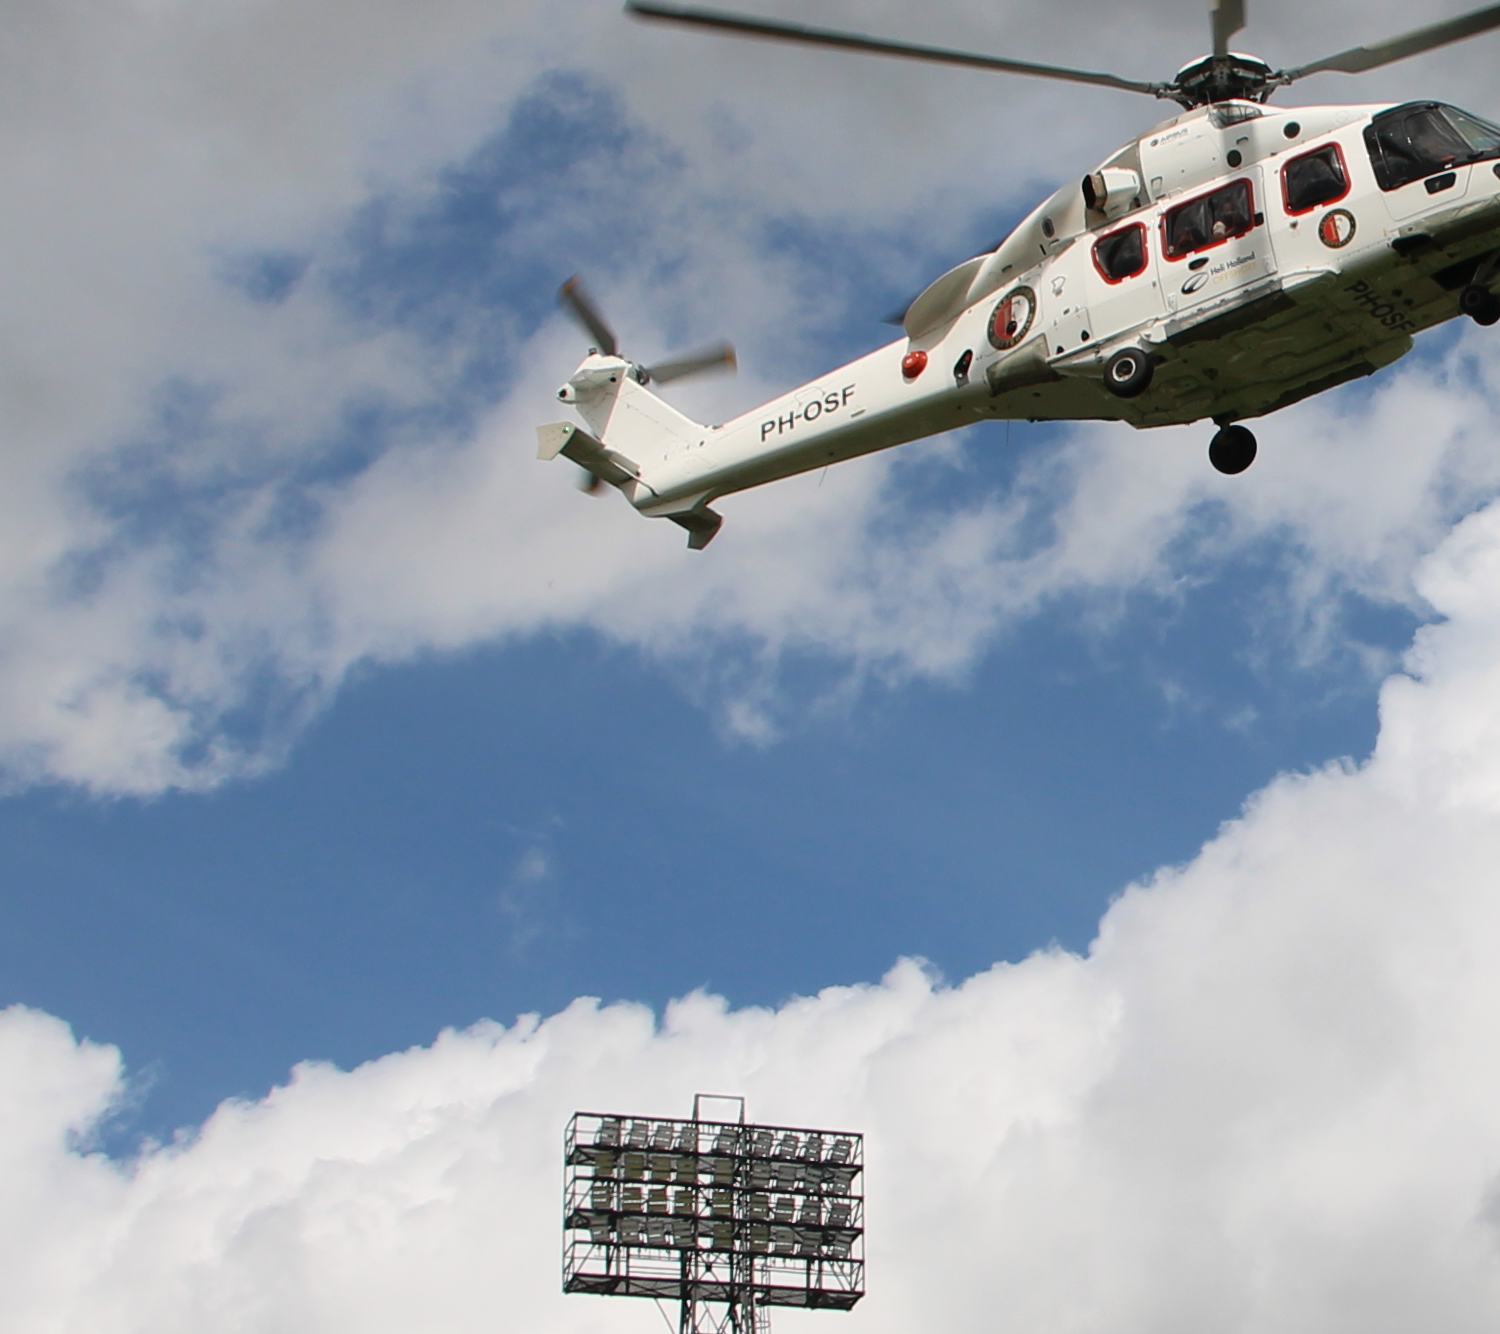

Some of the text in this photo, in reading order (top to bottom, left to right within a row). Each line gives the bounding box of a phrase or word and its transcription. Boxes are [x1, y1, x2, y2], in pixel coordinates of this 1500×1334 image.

[1210, 251, 1255, 275] Heli Holland
[1343, 279, 1416, 330] PH-OSF
[761, 383, 856, 442] PH-OSF
